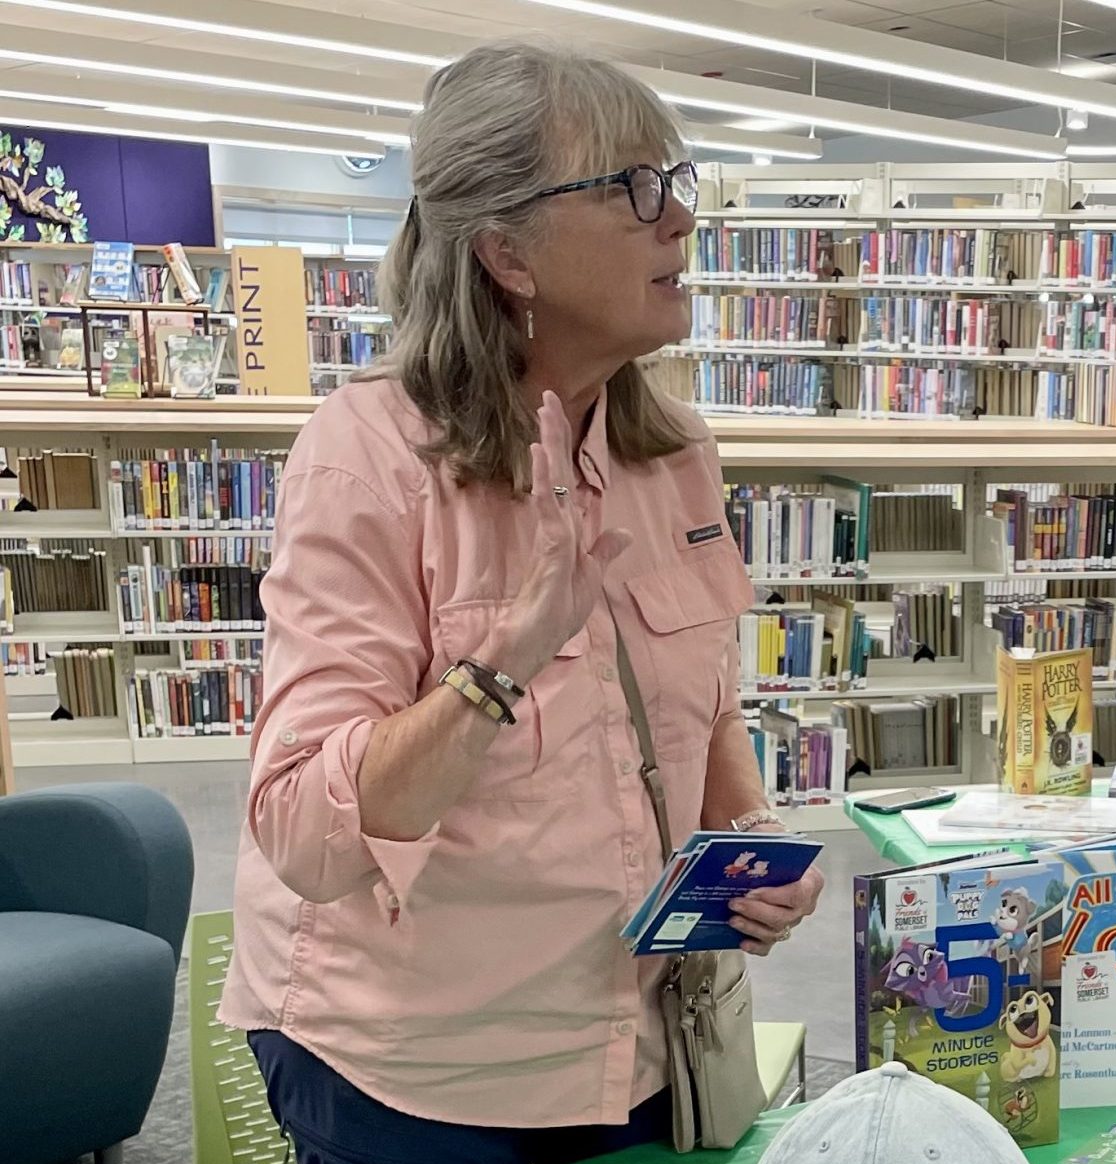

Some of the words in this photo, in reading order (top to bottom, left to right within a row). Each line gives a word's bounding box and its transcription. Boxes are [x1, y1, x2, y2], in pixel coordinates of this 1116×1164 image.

[239, 257, 265, 370] PRINT
[1043, 660, 1081, 682] HARRY
[1022, 683, 1033, 717] HARRY
[1042, 678, 1083, 701] POTTER
[1022, 719, 1033, 756] POTTER
[1072, 878, 1111, 909] All
[895, 915, 928, 926] SOMERSET
